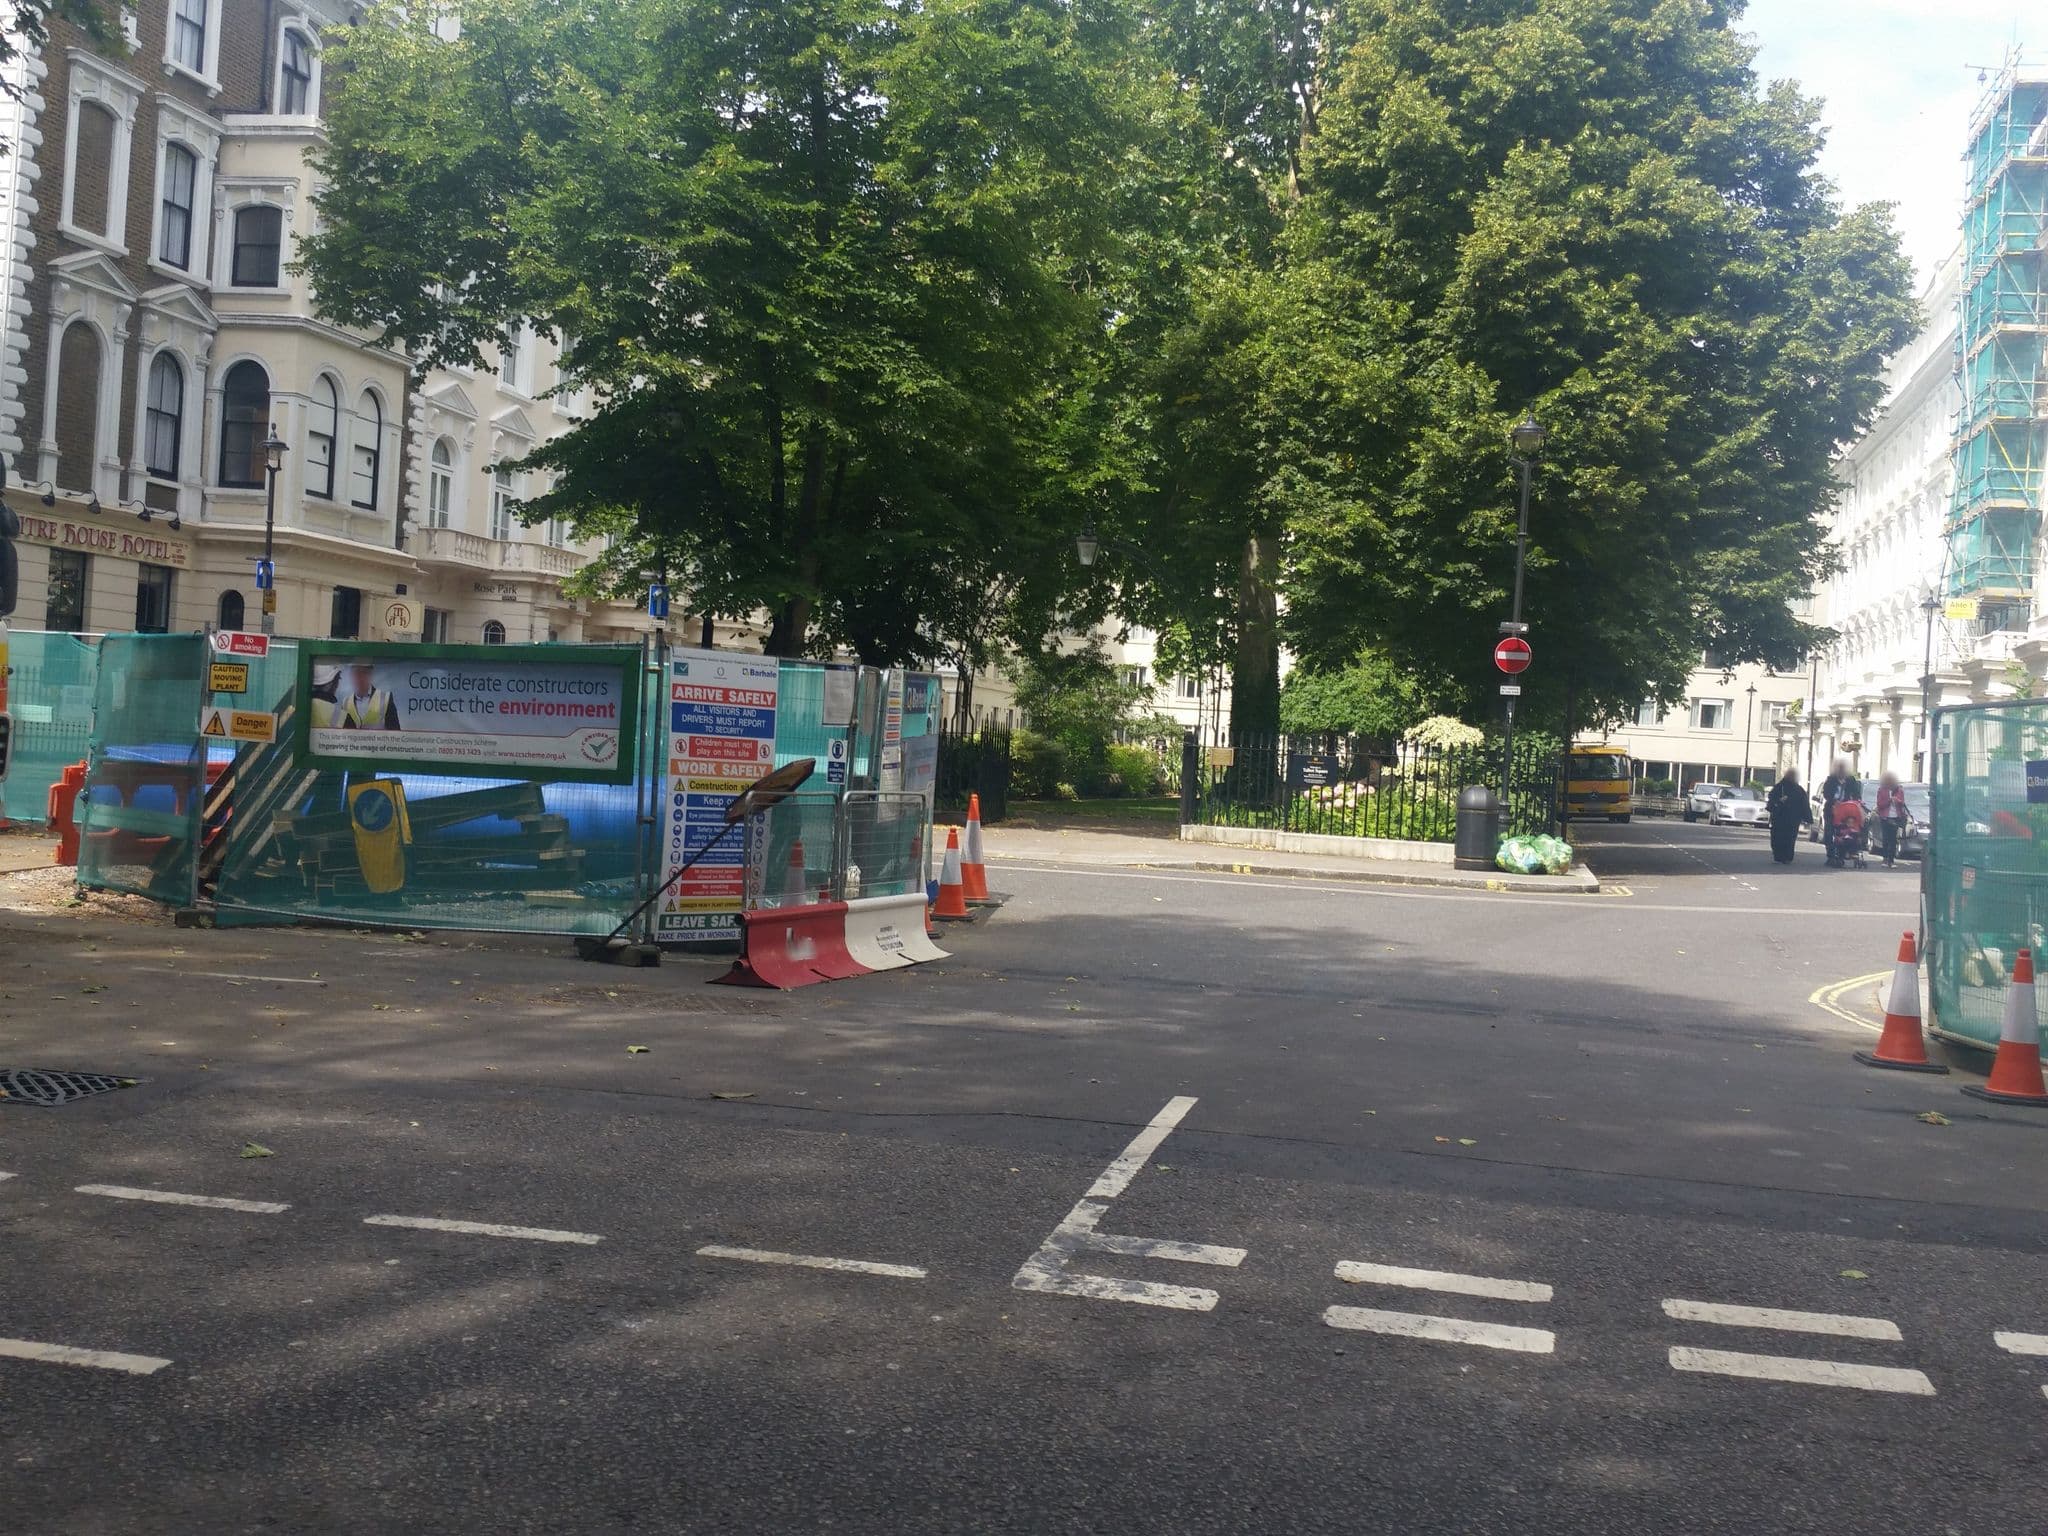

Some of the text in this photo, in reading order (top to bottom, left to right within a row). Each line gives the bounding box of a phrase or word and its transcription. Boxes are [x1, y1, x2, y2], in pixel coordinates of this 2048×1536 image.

[19, 516, 57, 540] ITRE
[64, 523, 117, 550] HOUSE
[122, 534, 171, 560] HOTEL
[474, 582, 517, 594] Rose Park
[235, 644, 263, 654] smoking
[213, 665, 245, 673] CAUTION
[750, 668, 777, 679] Barhale
[214, 674, 243, 682] MOVING
[408, 671, 609, 696] Considerate constructors
[675, 685, 774, 705] ARRIVE SAFELY
[408, 695, 616, 719] protect the environment
[693, 704, 756, 718] ALL VISITORS AND
[236, 716, 268, 729] Danger
[681, 714, 766, 728] DRIVERS MUST REPORT
[705, 725, 745, 735] TO SECURITY
[695, 738, 723, 747] Children
[724, 739, 740, 748] must
[349, 743, 360, 751] the
[361, 744, 378, 753] image
[379, 744, 386, 752] of
[386, 745, 424, 753] construction
[498, 750, 567, 761] www.ccscheme.org.uk
[696, 747, 711, 757] play
[723, 748, 736, 756] this
[738, 749, 750, 757] site
[677, 761, 767, 777] WORK SAFELY
[689, 780, 738, 791] Construction
[703, 796, 724, 807] Keep
[665, 914, 737, 928] LEAVE SAF
[658, 931, 674, 941] TAKE
[676, 931, 696, 940] PRIDE
[697, 930, 705, 939] IN
[706, 930, 736, 939] WORKING
